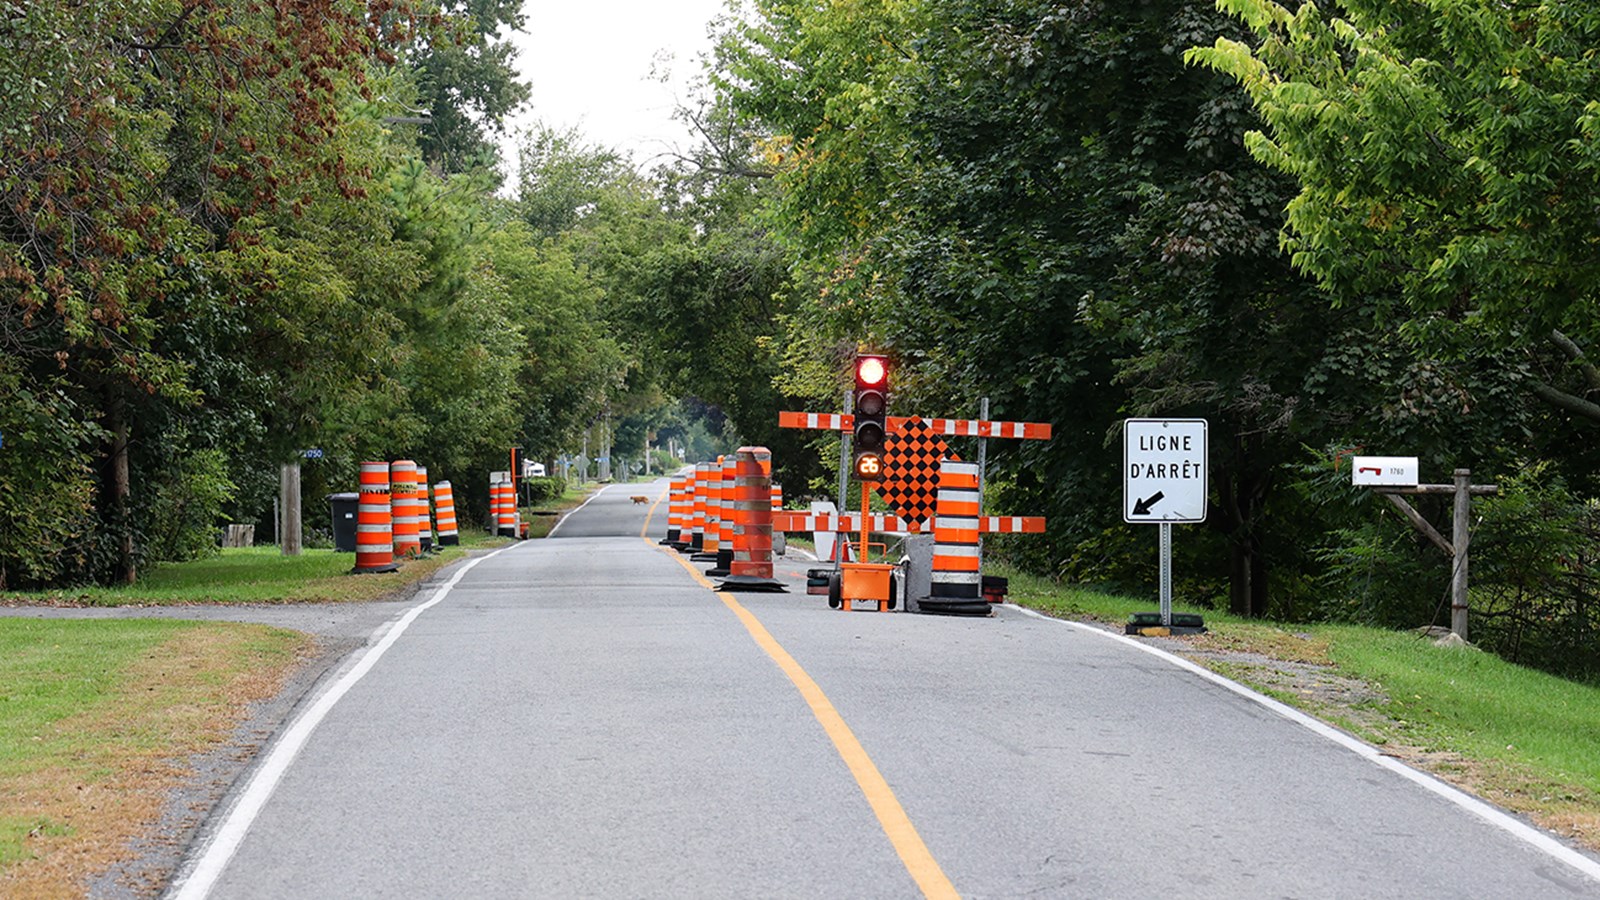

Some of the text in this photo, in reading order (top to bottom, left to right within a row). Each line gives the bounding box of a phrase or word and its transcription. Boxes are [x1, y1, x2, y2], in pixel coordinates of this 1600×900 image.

[1140, 435, 1191, 451] LIGNE
[860, 457, 879, 473] 26
[1131, 459, 1200, 479] D'ARRÊT
